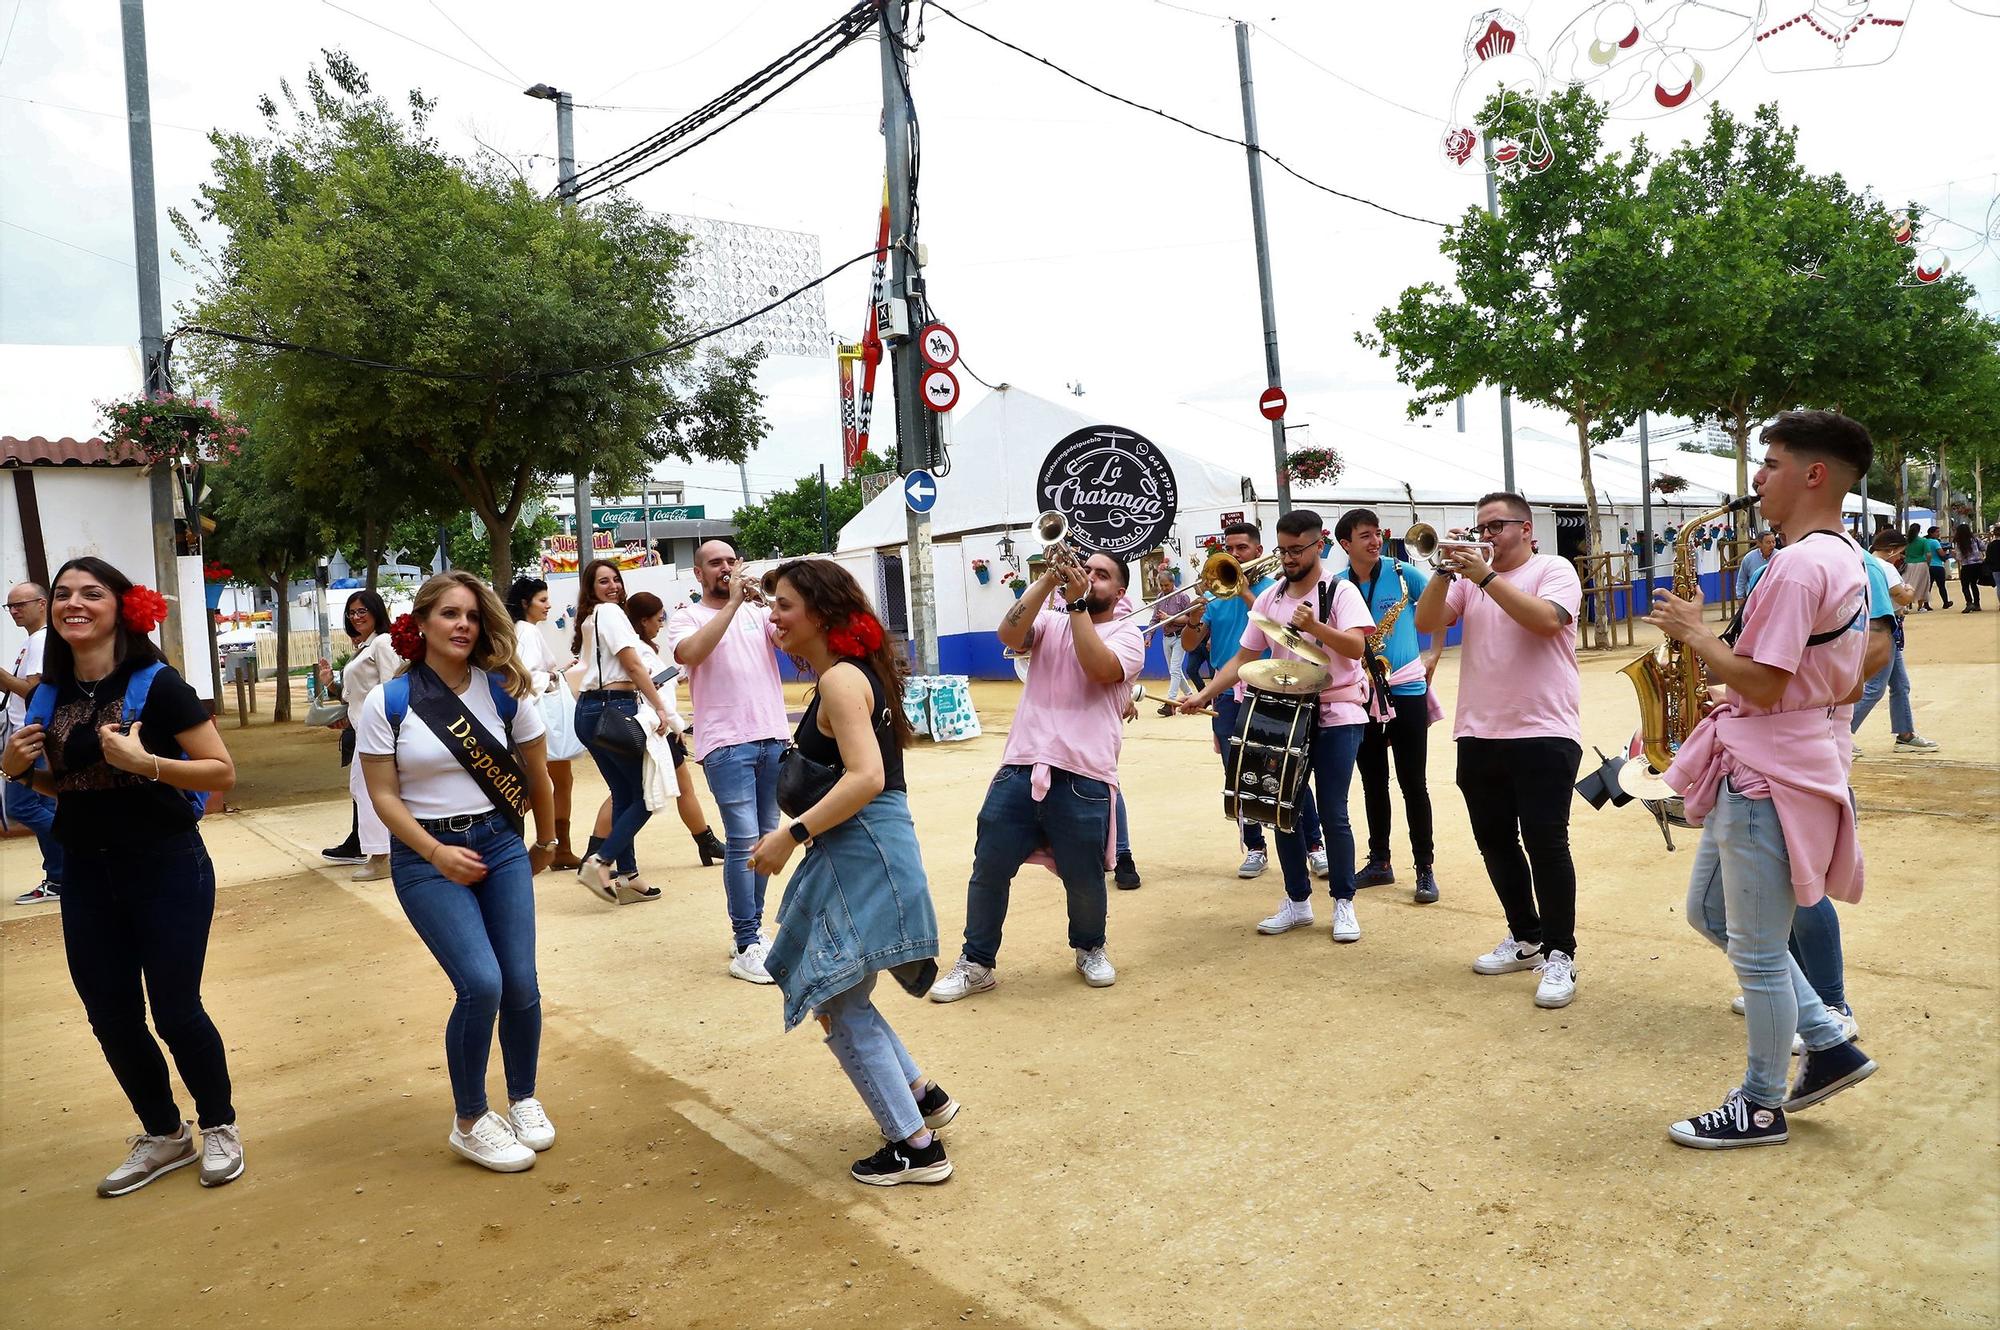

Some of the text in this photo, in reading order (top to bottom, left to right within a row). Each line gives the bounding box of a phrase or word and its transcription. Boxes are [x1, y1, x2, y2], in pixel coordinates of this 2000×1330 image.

[1090, 455, 1123, 486] La
[1148, 455, 1175, 507] 641 379 331
[1044, 476, 1164, 515] Charanga
[1072, 523, 1144, 547] DEL PUEBLO
